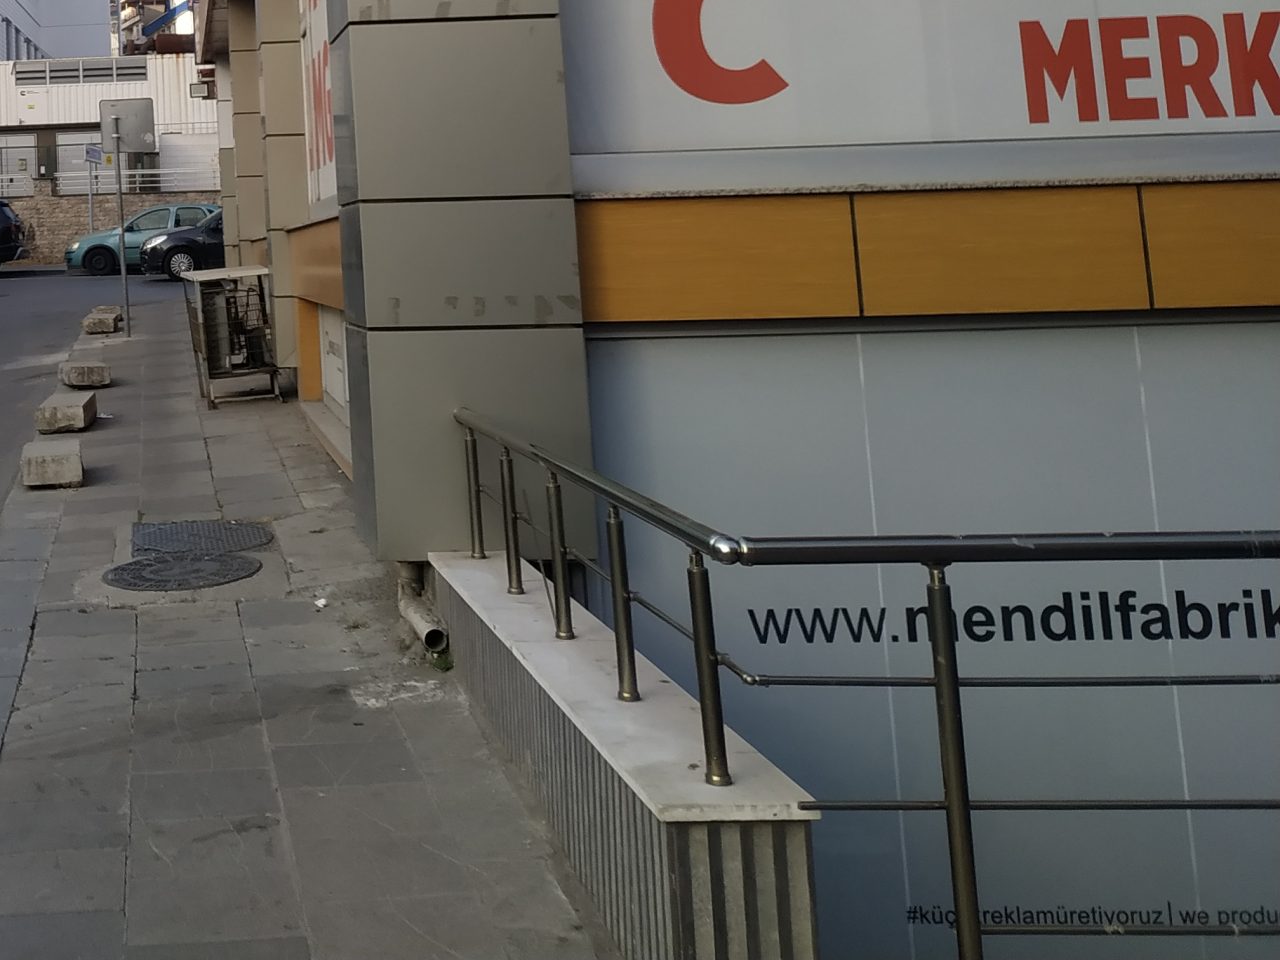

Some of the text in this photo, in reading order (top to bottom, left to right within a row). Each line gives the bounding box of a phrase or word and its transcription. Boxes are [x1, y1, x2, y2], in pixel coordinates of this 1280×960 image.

[1019, 10, 1280, 124] MERK
[906, 904, 1163, 928] #küçreklamüretiyoruz
[1178, 909, 1209, 925] we
